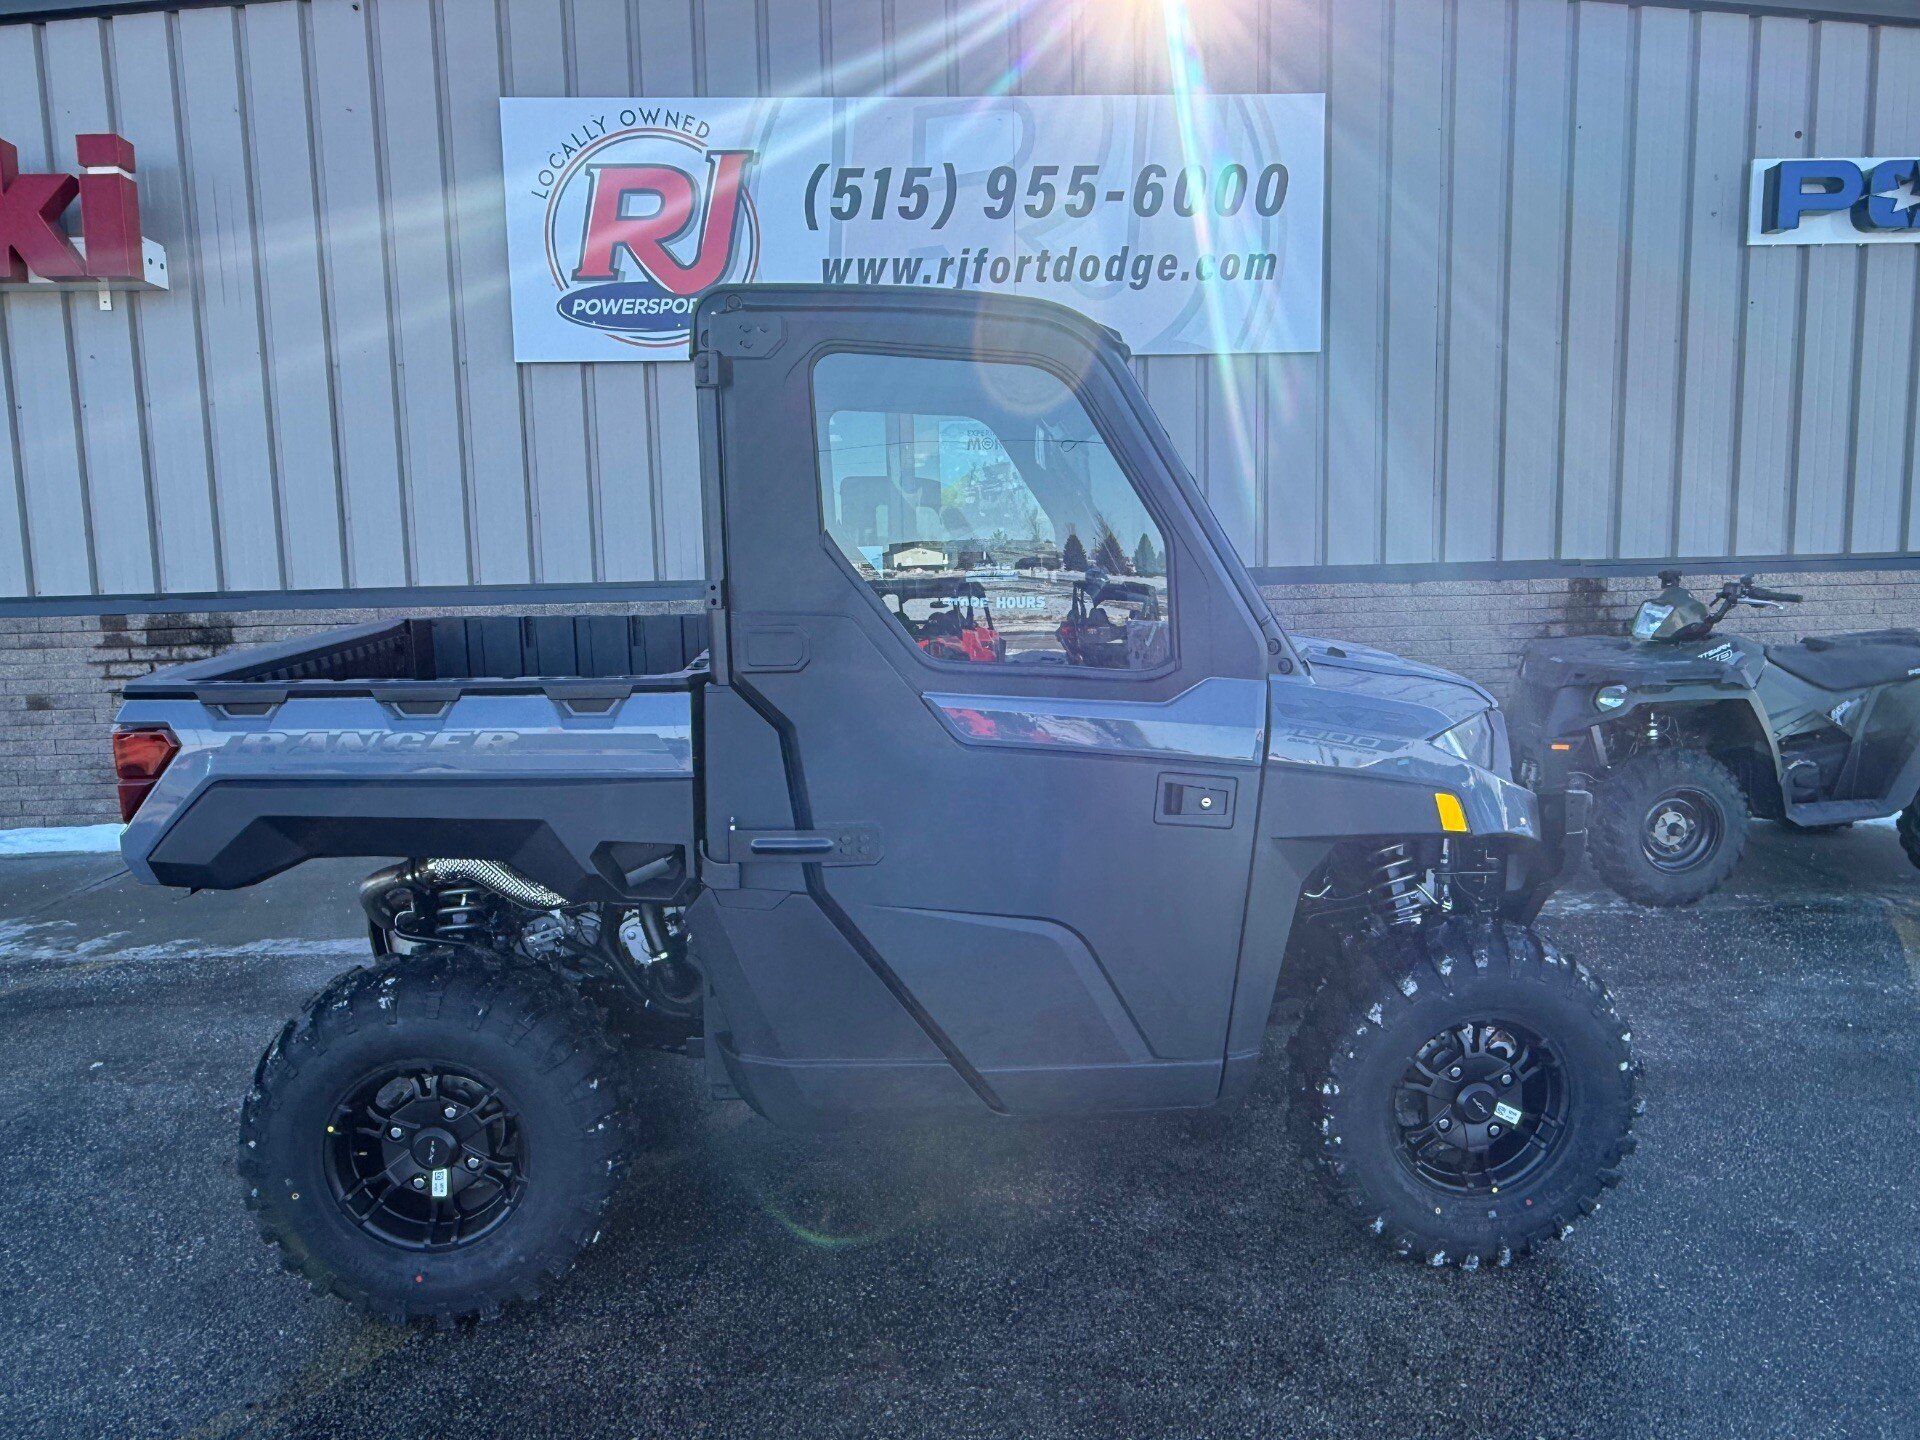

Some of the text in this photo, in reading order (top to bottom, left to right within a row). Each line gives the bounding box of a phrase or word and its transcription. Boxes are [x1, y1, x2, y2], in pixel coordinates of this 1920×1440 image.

[531, 107, 711, 200] LOCALLY OWNED
[571, 149, 758, 295] RJ
[804, 162, 1290, 231] (515) 955-6000
[821, 246, 1278, 291] www.rjfortdodge.com
[996, 596, 1046, 609] HOURS
[240, 730, 520, 754] RANGER
